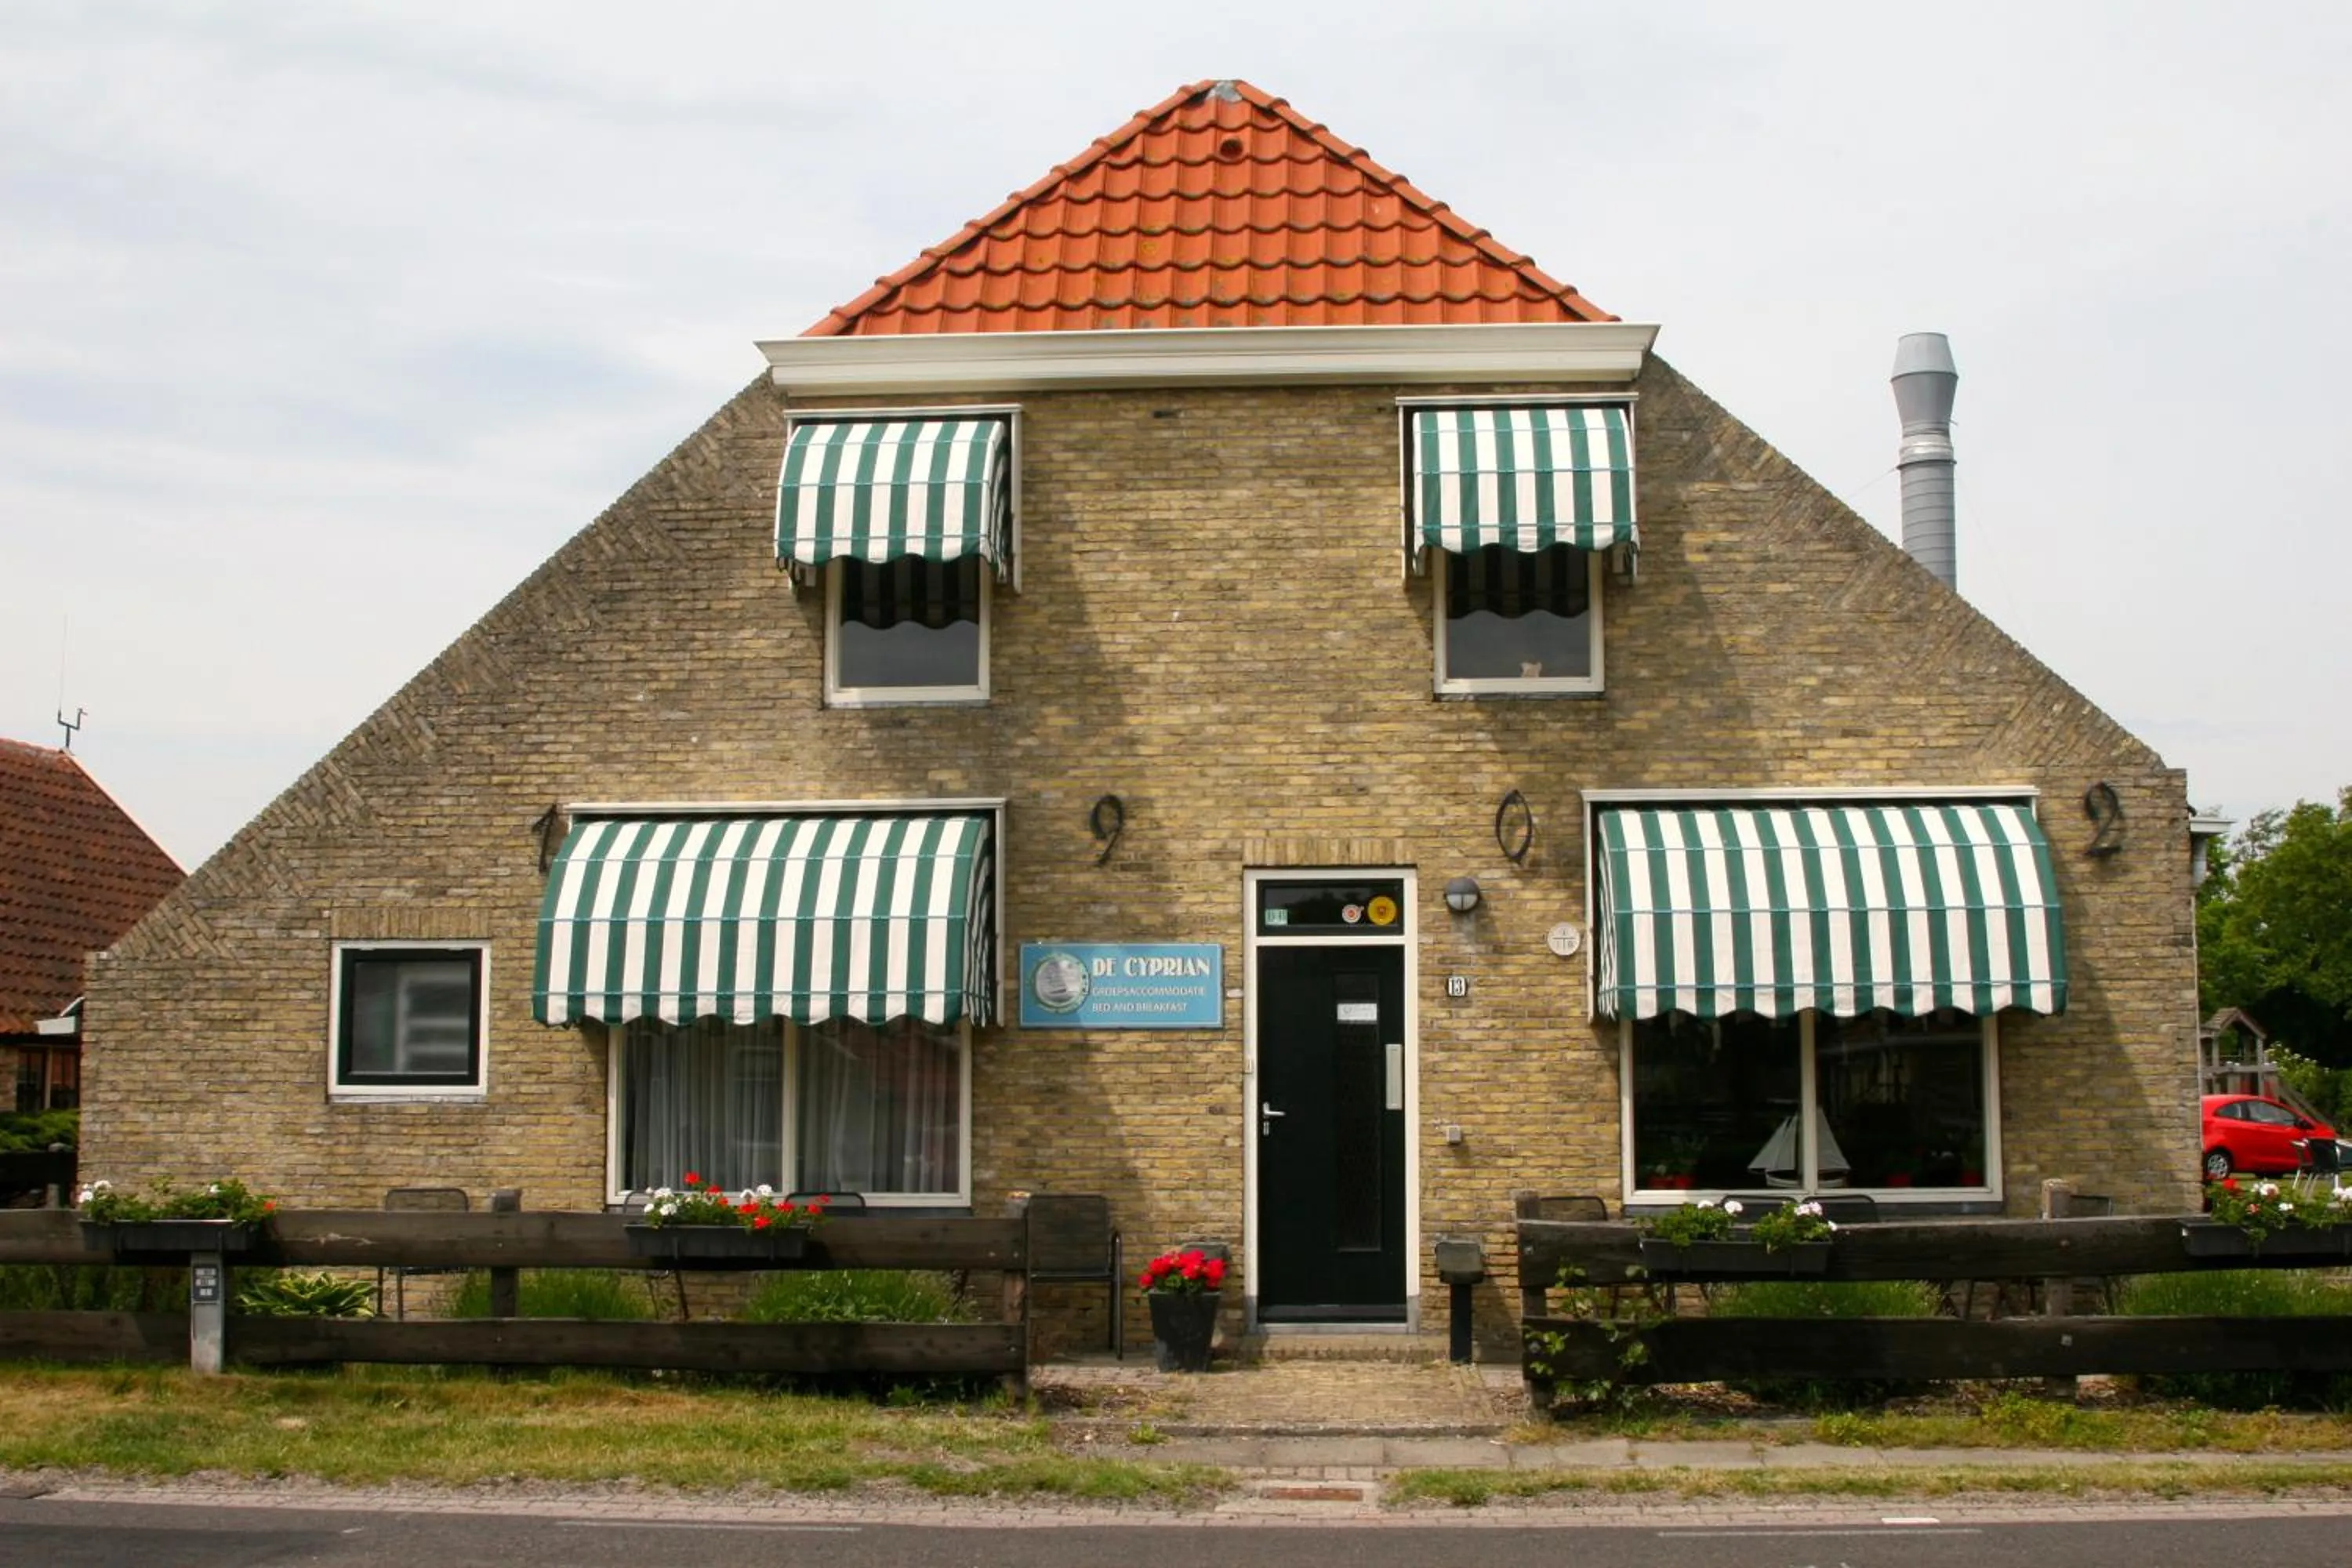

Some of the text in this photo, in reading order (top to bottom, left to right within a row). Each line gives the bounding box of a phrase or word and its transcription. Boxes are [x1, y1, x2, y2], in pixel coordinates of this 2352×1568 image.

[1092, 956, 1210, 978] DE CYPRIAN
[1451, 978, 1462, 994] 13
[1092, 1002, 1187, 1012] BED AND BREAKFAST
